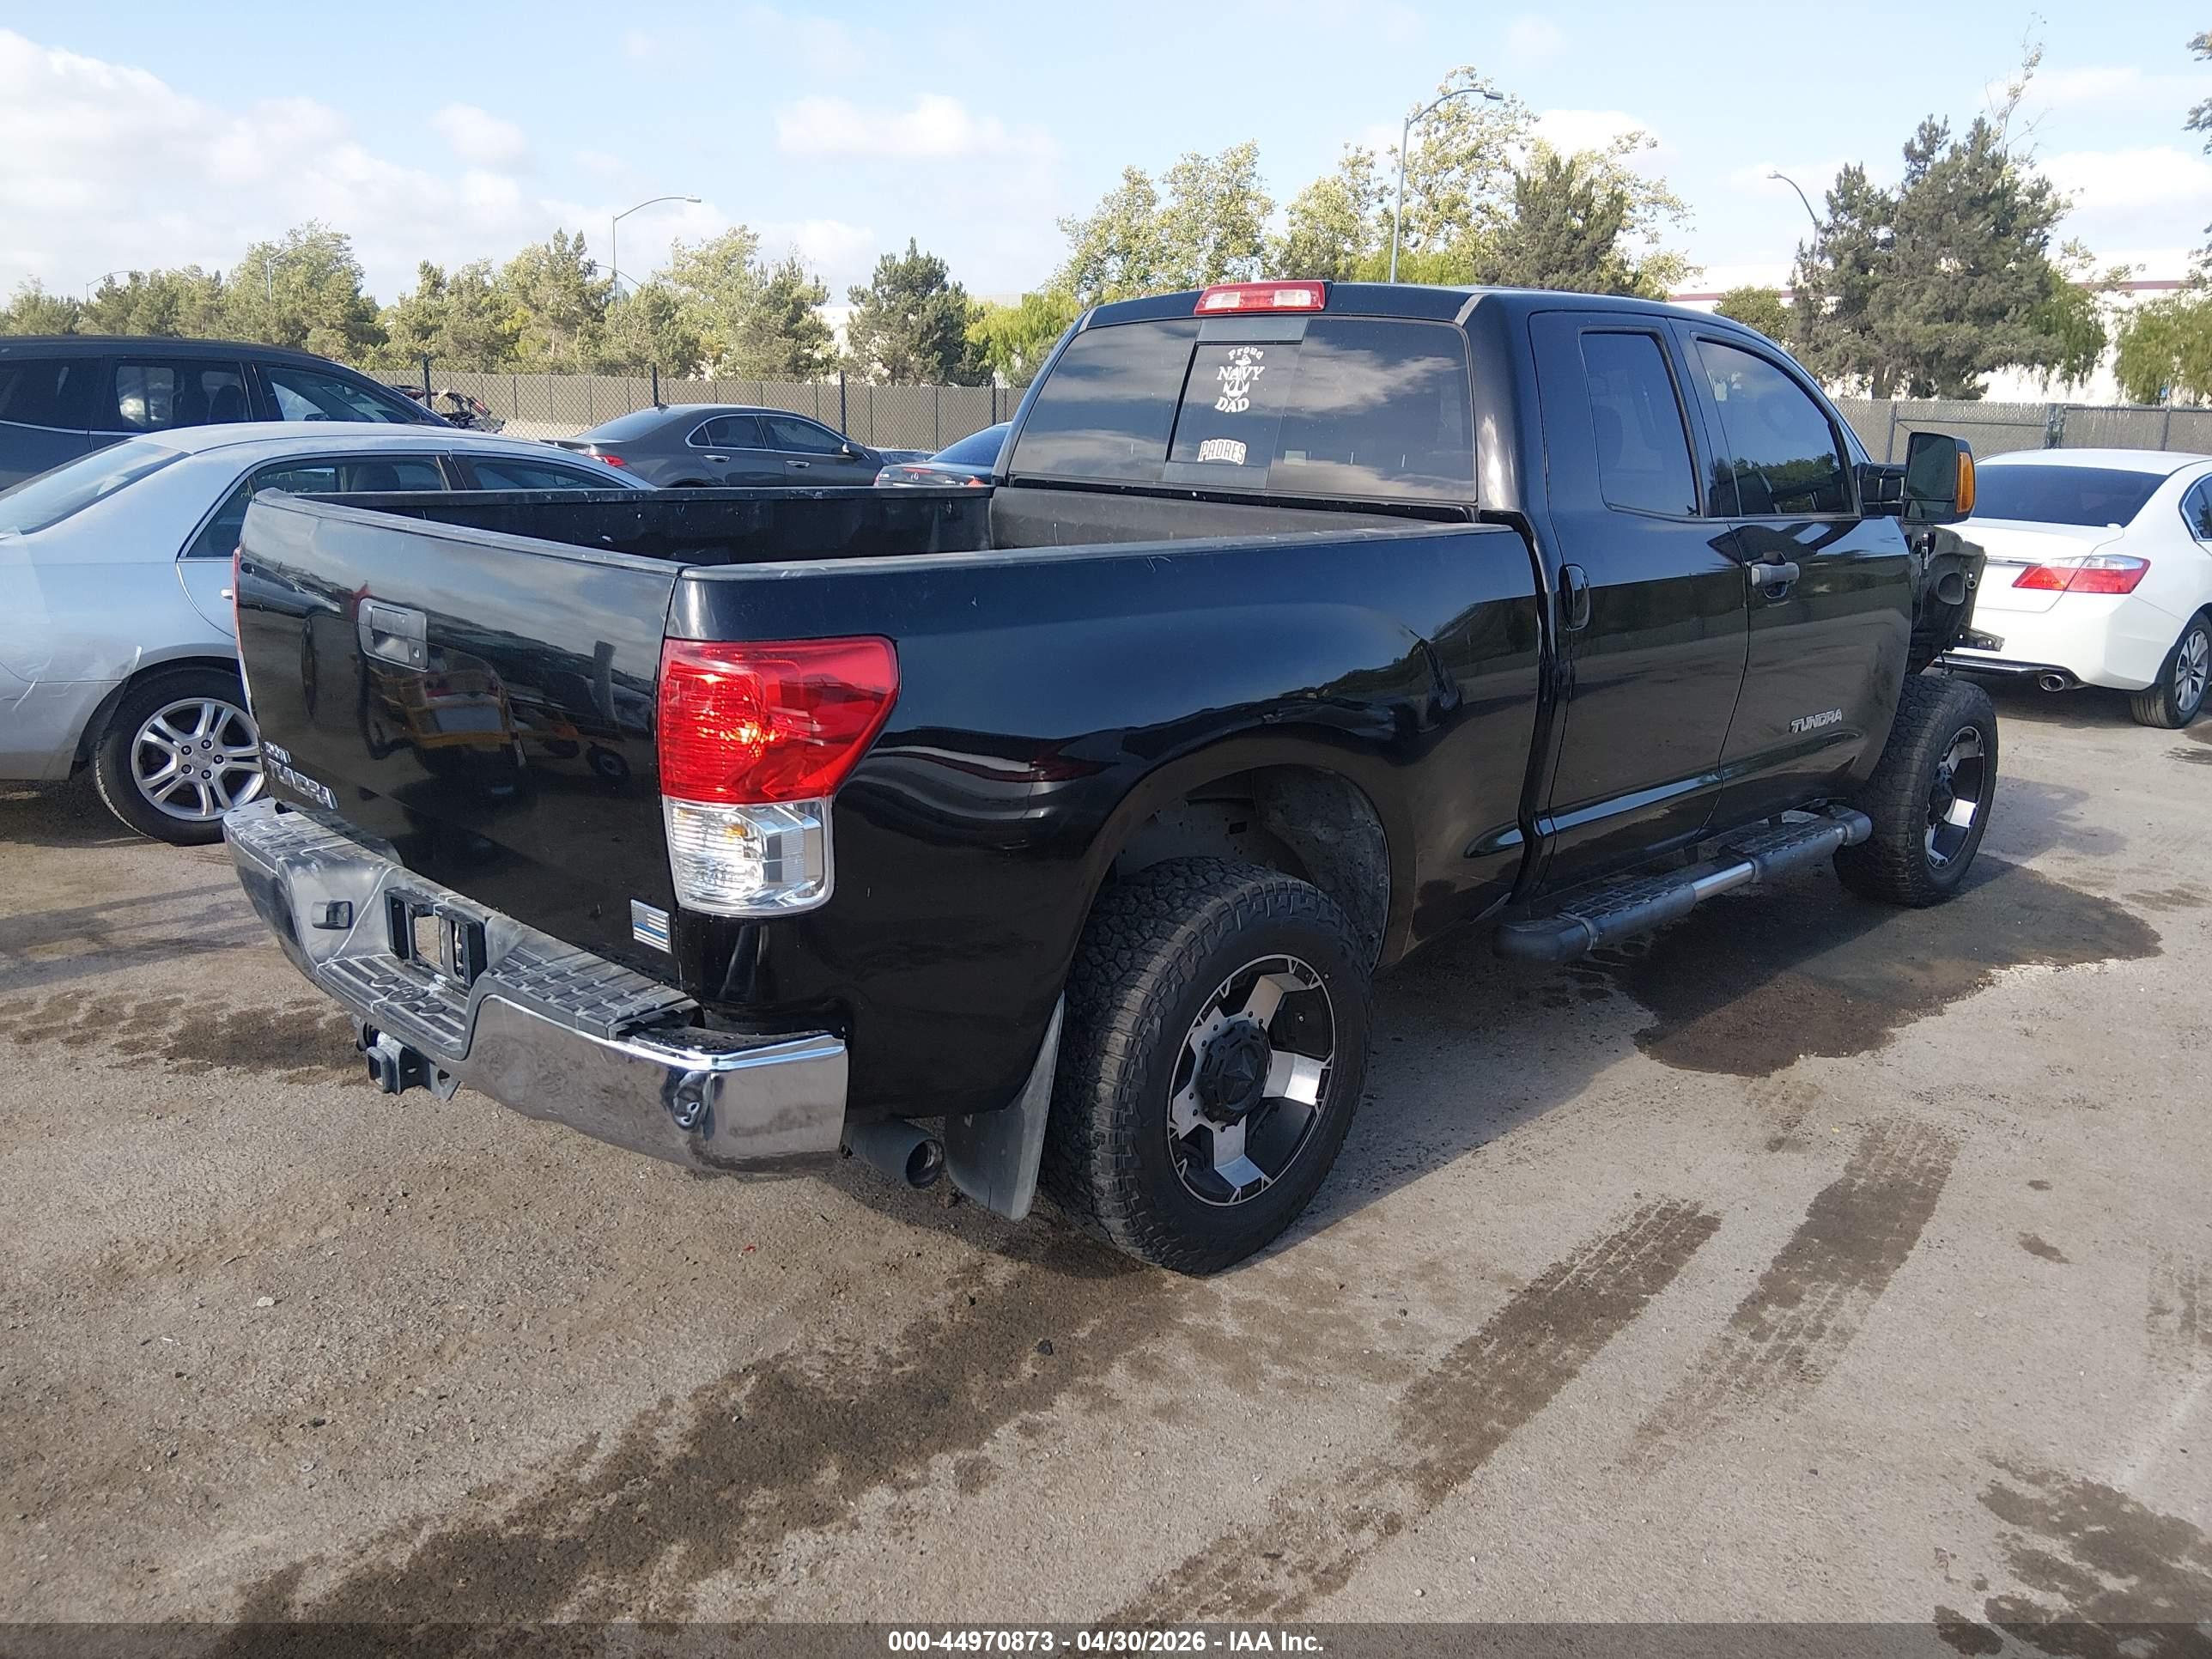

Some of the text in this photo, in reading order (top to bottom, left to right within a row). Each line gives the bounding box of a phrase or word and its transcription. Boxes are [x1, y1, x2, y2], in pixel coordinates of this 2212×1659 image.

[1228, 346, 1264, 361] Proud
[1216, 366, 1266, 380] NAVY
[1214, 397, 1250, 412] DAD
[1197, 439, 1247, 465] PADRES
[1790, 708, 1843, 733] TUNDRA
